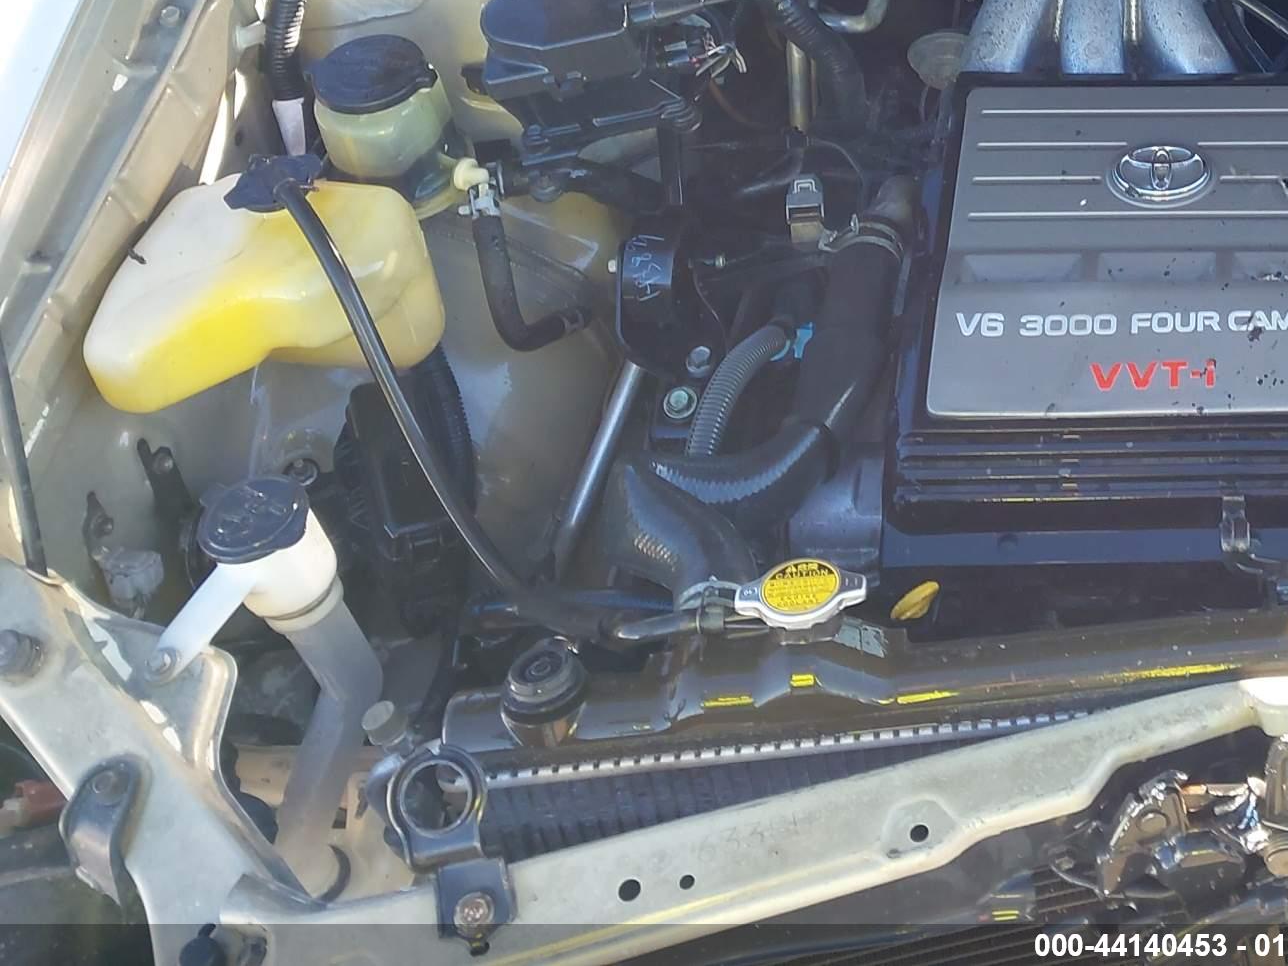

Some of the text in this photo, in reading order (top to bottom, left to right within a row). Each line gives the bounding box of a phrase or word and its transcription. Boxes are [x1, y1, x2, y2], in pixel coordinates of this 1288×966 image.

[956, 312, 1004, 336] V6
[1020, 313, 1117, 336] 3000
[1131, 310, 1221, 334] FOUR
[1090, 358, 1217, 392] VVT-i
[775, 568, 828, 579] CAUTION
